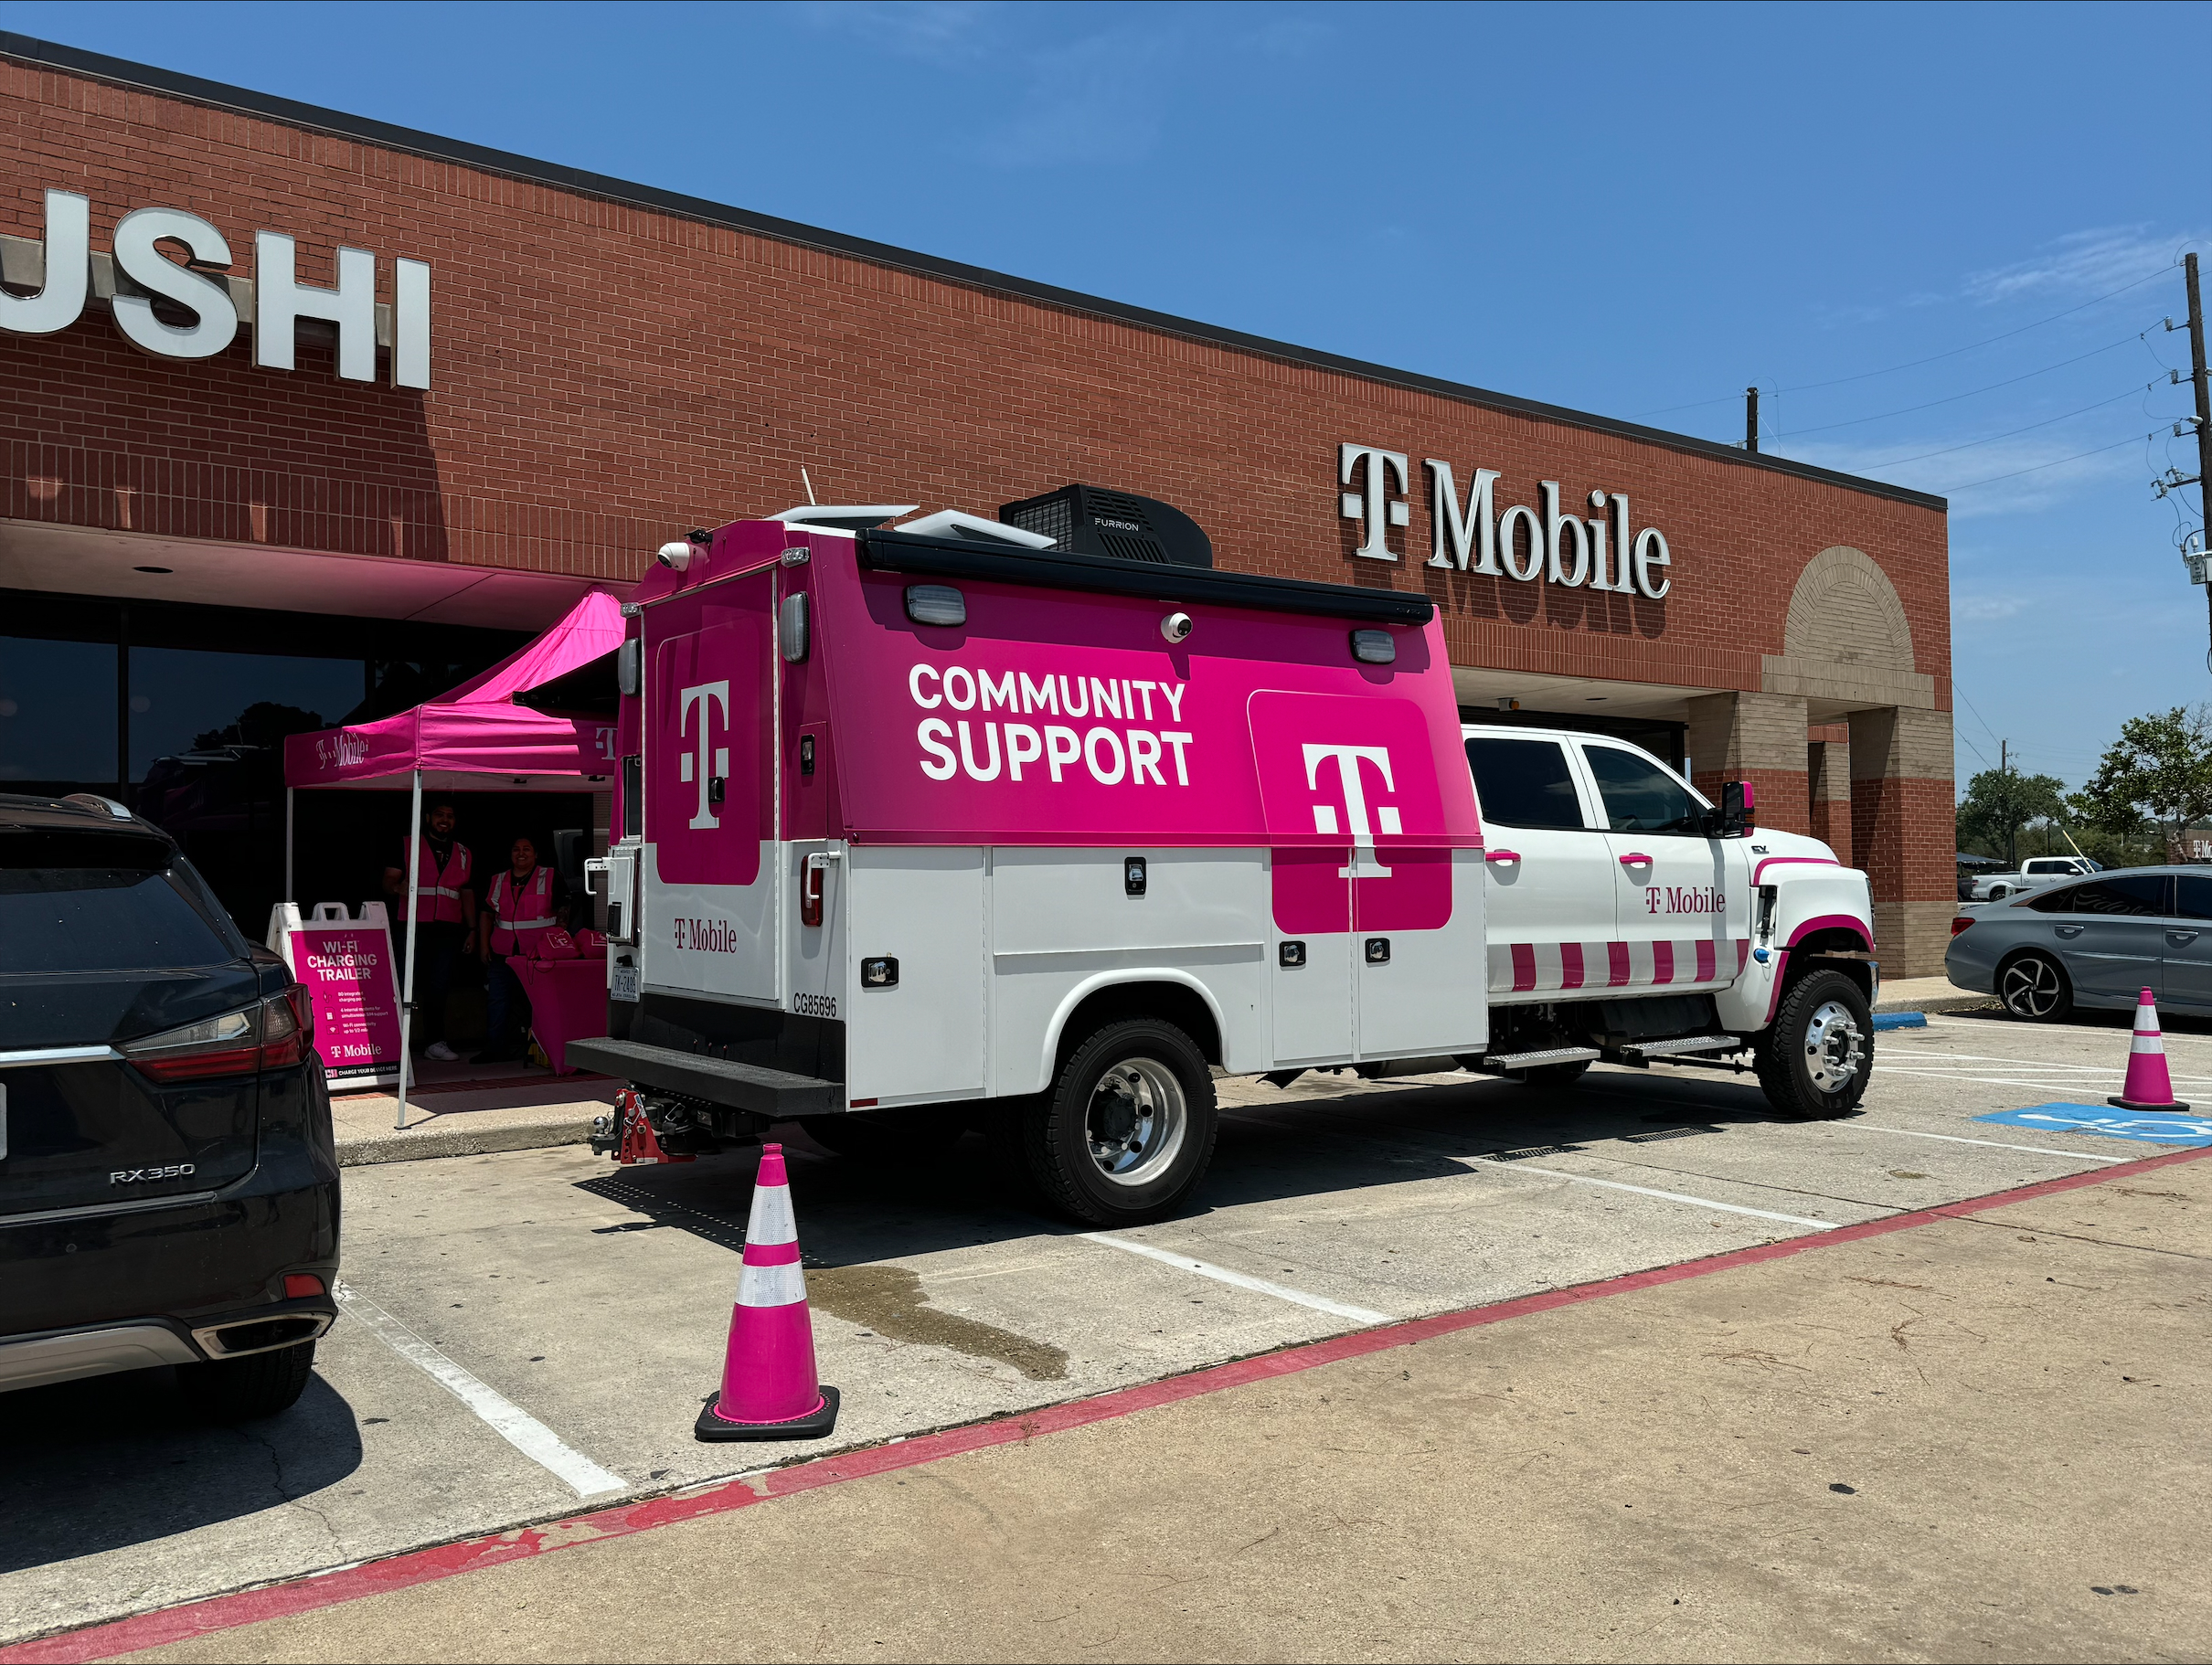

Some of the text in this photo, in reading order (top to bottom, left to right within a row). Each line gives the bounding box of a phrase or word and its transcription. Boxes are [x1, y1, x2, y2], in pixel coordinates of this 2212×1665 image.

[0, 187, 431, 390] USHI
[1094, 517, 1139, 532] FURRION
[1339, 441, 1671, 599] T Mobile
[908, 663, 1186, 722] COMMUNITY
[917, 717, 1194, 786] SUPPORT
[1645, 886, 1726, 914] T Mobile
[323, 940, 358, 953] WI-FI
[675, 917, 737, 954] T Mobile
[307, 953, 378, 969] CHARGING
[317, 967, 372, 981] TRAILER
[793, 992, 836, 1017] CG85696
[331, 1043, 382, 1058] T Mobile
[110, 1163, 196, 1184] RX 350
